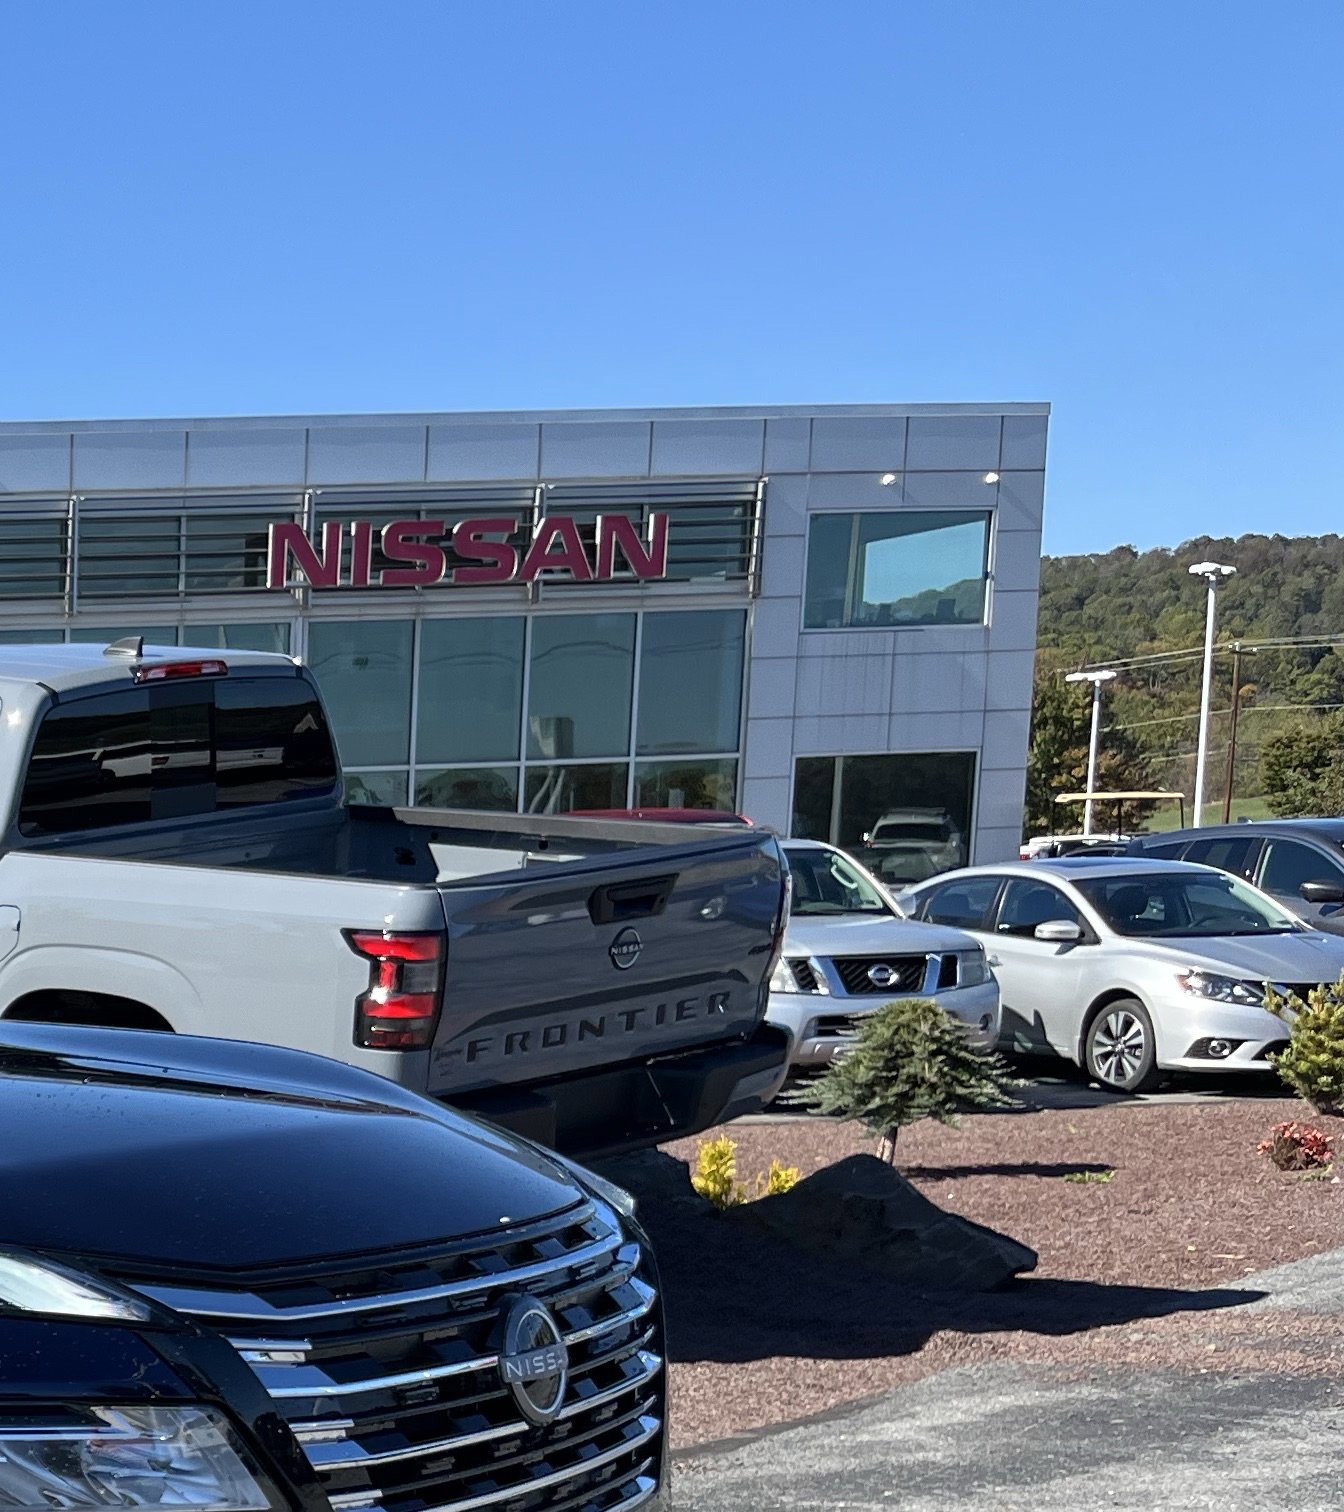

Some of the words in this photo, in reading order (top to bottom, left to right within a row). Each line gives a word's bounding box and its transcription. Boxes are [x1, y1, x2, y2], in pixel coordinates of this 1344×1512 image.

[266, 513, 668, 590] NISSAN
[465, 991, 731, 1064] FRONTIER
[505, 1349, 564, 1379] NISS
